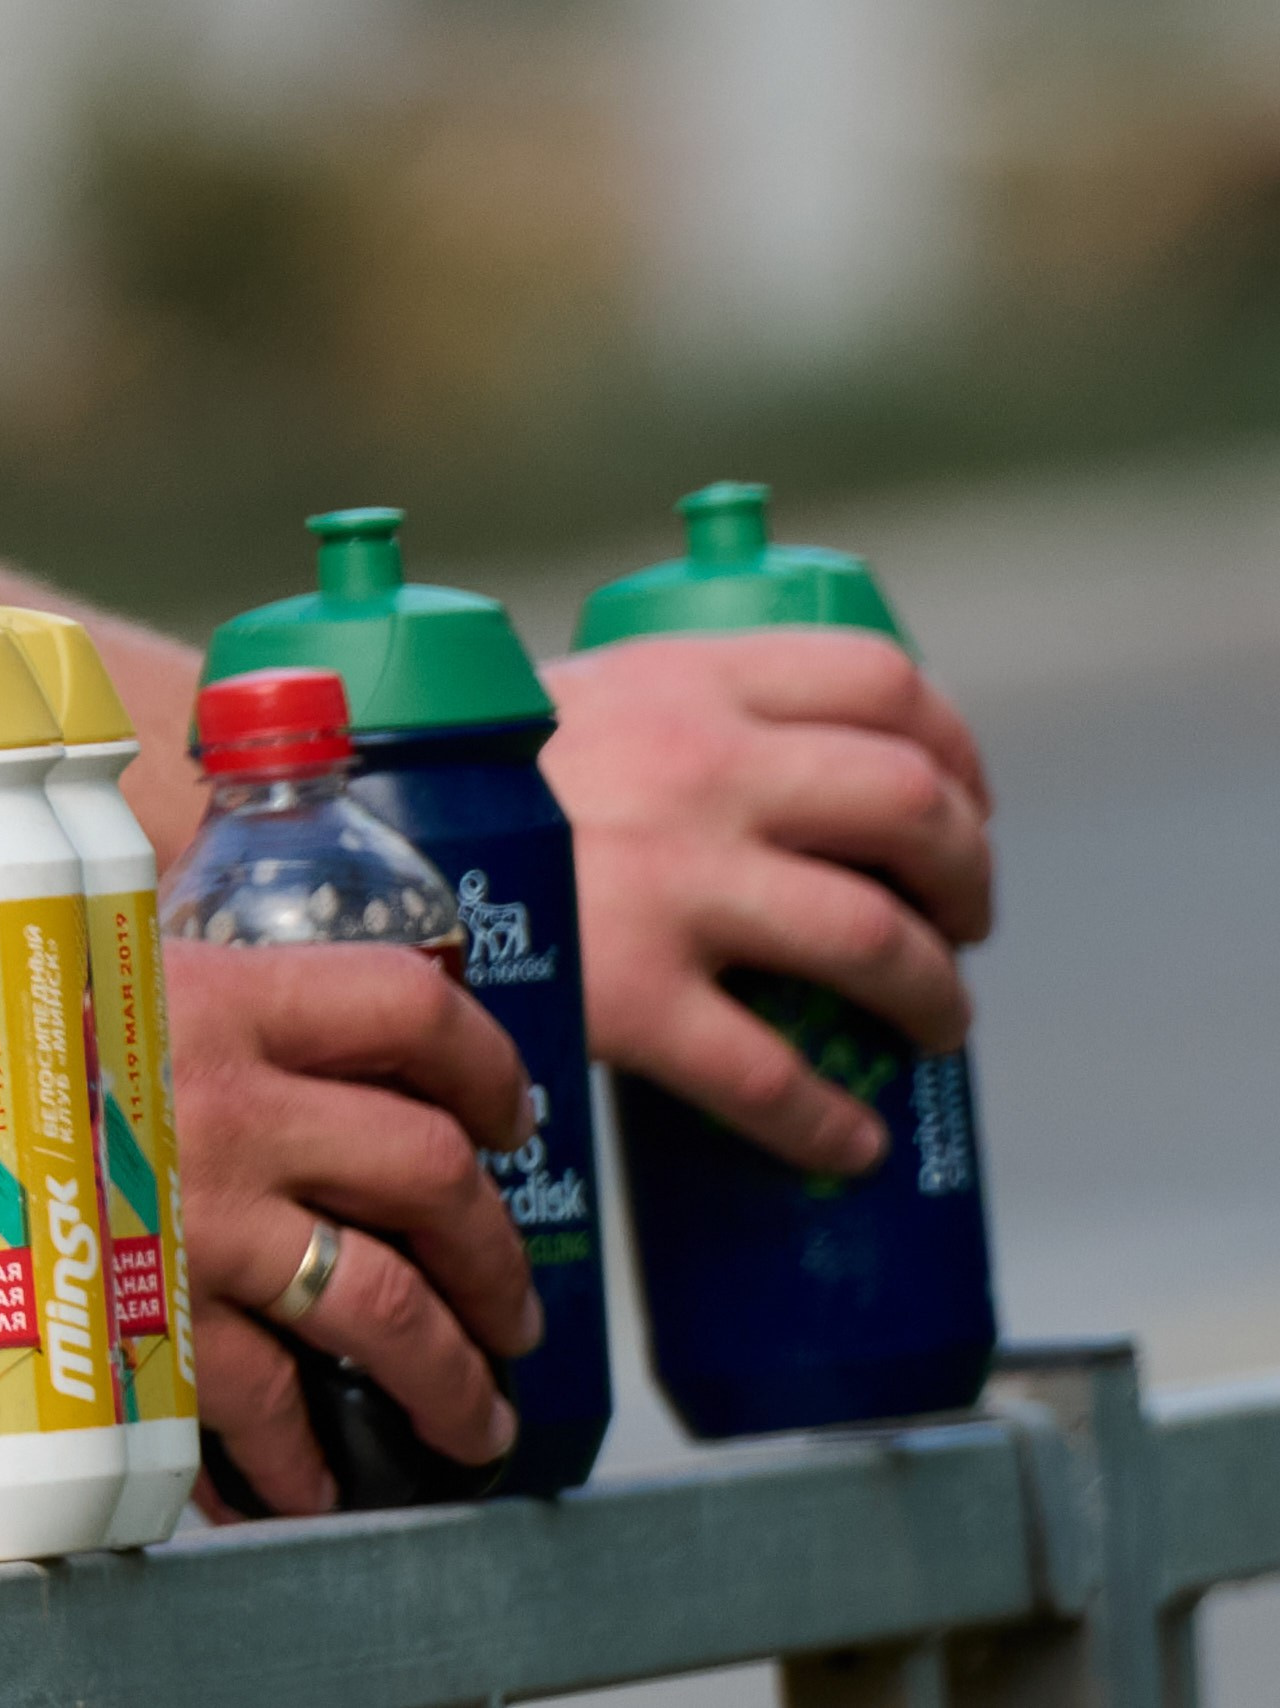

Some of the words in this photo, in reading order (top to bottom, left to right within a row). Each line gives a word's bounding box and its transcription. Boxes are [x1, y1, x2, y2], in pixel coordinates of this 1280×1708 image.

[115, 911, 133, 977] 2019
[121, 983, 138, 1045] МАЯ
[127, 1052, 144, 1125] 11-19
[114, 1299, 161, 1322] ДЕЛЯ
